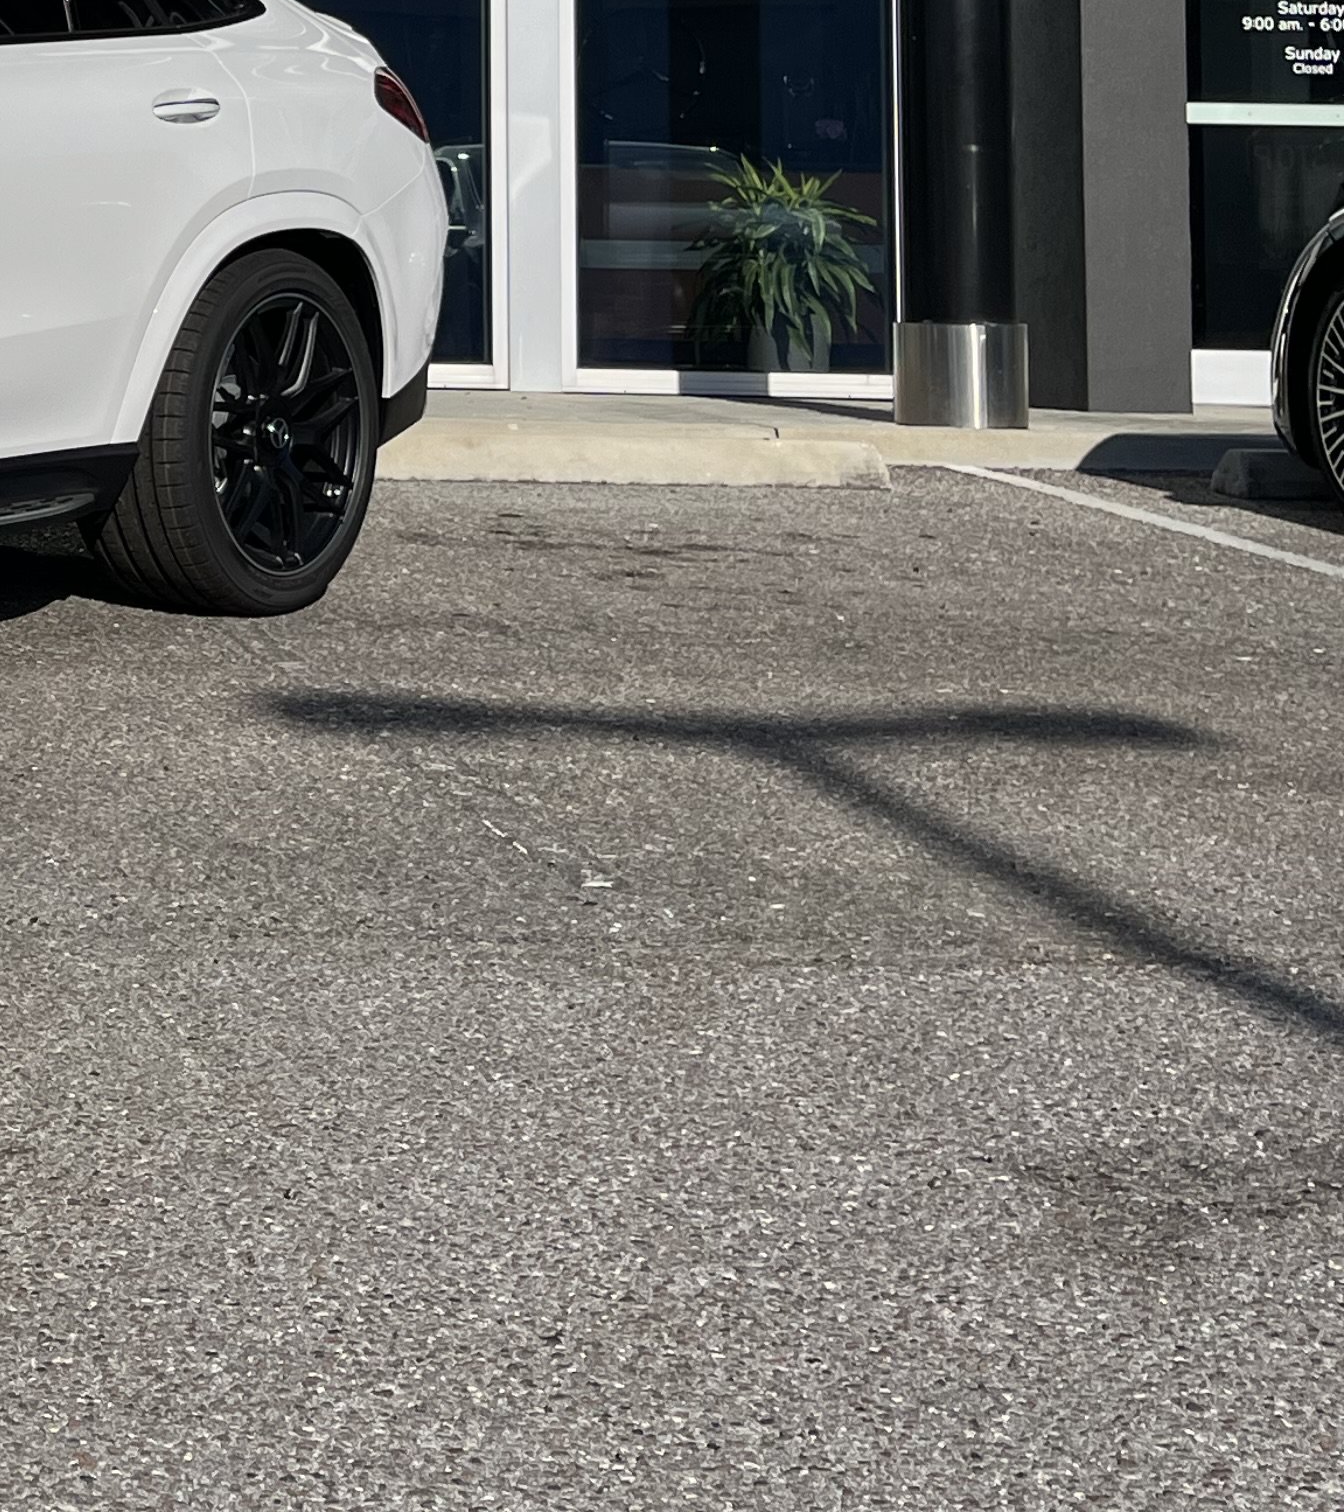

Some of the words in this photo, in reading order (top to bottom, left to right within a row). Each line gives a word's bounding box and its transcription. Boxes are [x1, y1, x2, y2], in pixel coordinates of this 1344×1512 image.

[1277, 0, 1344, 18] Saturday
[1242, 16, 1274, 31] 9:00
[1320, 17, 1344, 32] 6:0
[1285, 46, 1340, 64] Sunday
[1292, 63, 1333, 75] Closed
